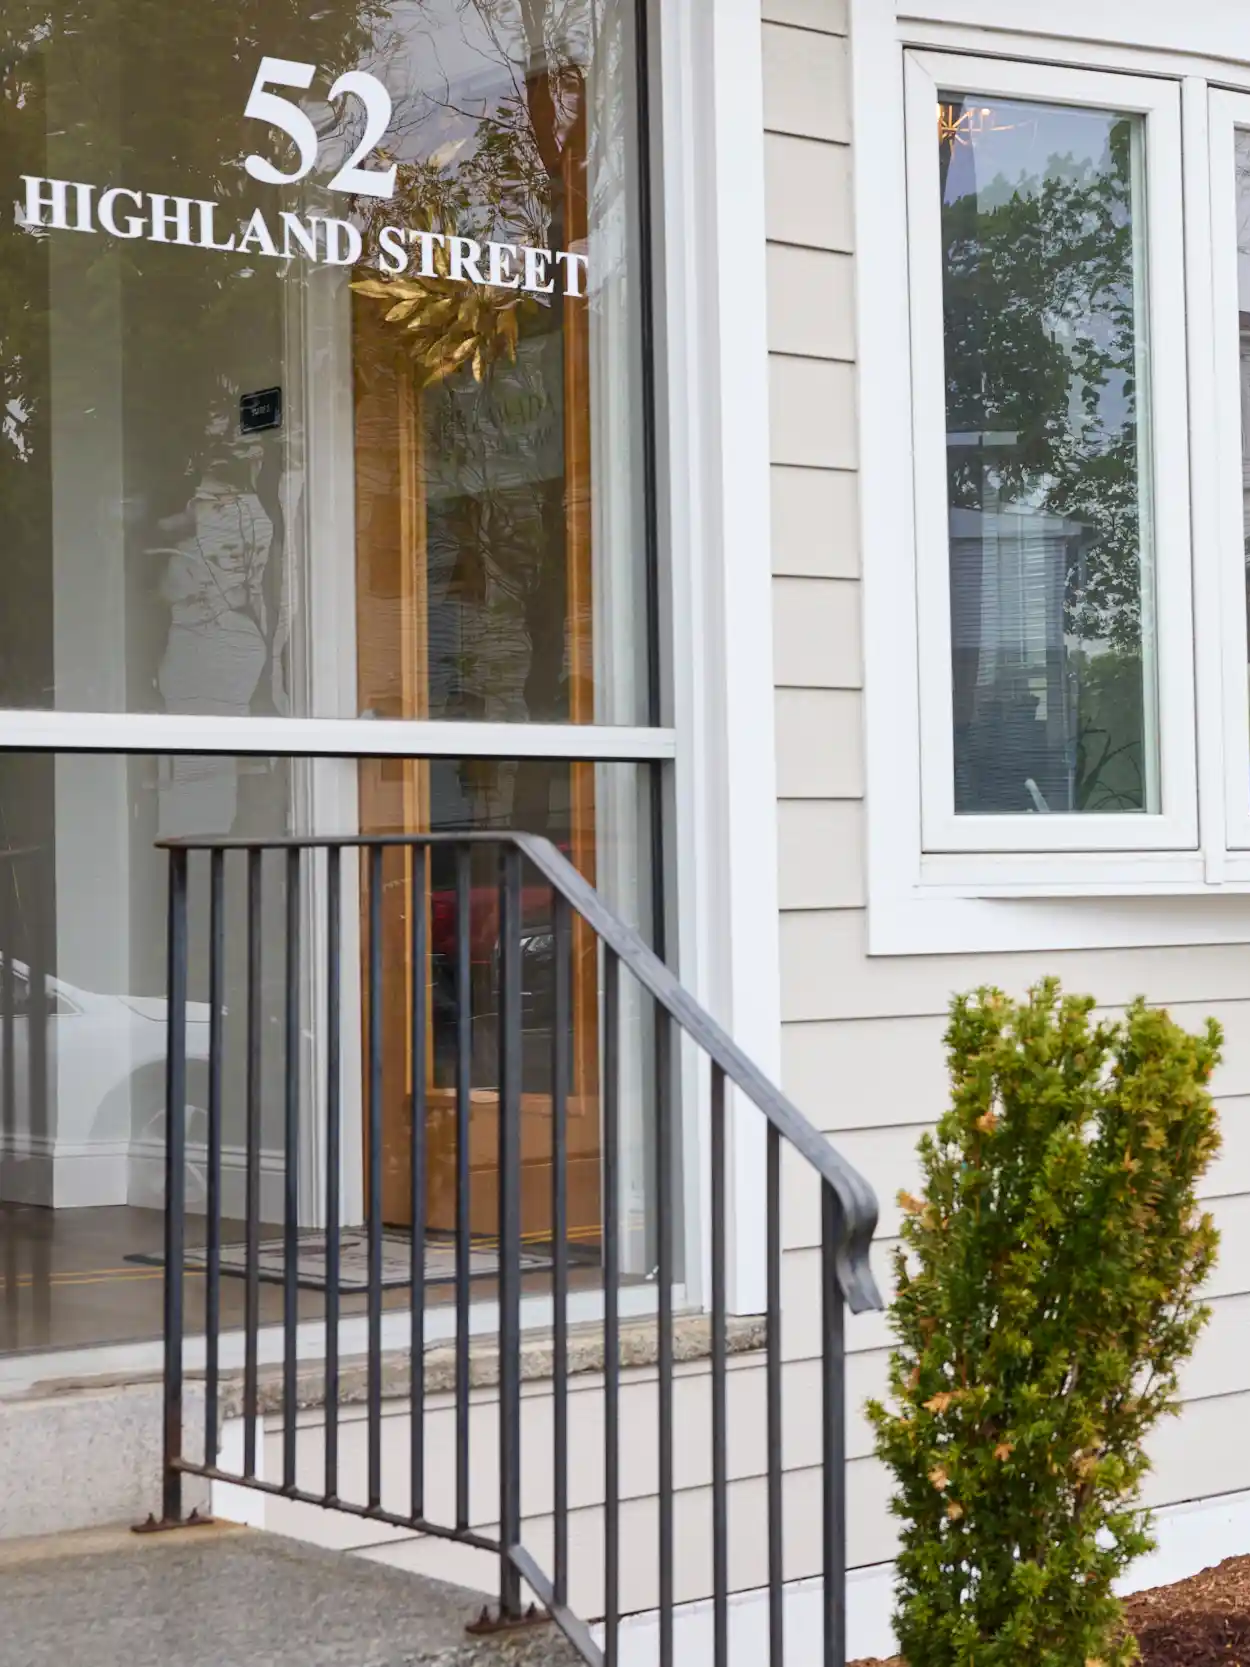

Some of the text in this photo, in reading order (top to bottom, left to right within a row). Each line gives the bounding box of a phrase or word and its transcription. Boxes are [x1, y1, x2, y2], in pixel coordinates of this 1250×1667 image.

[244, 56, 397, 199] 52
[19, 174, 589, 298] HIGHLAND STREET
